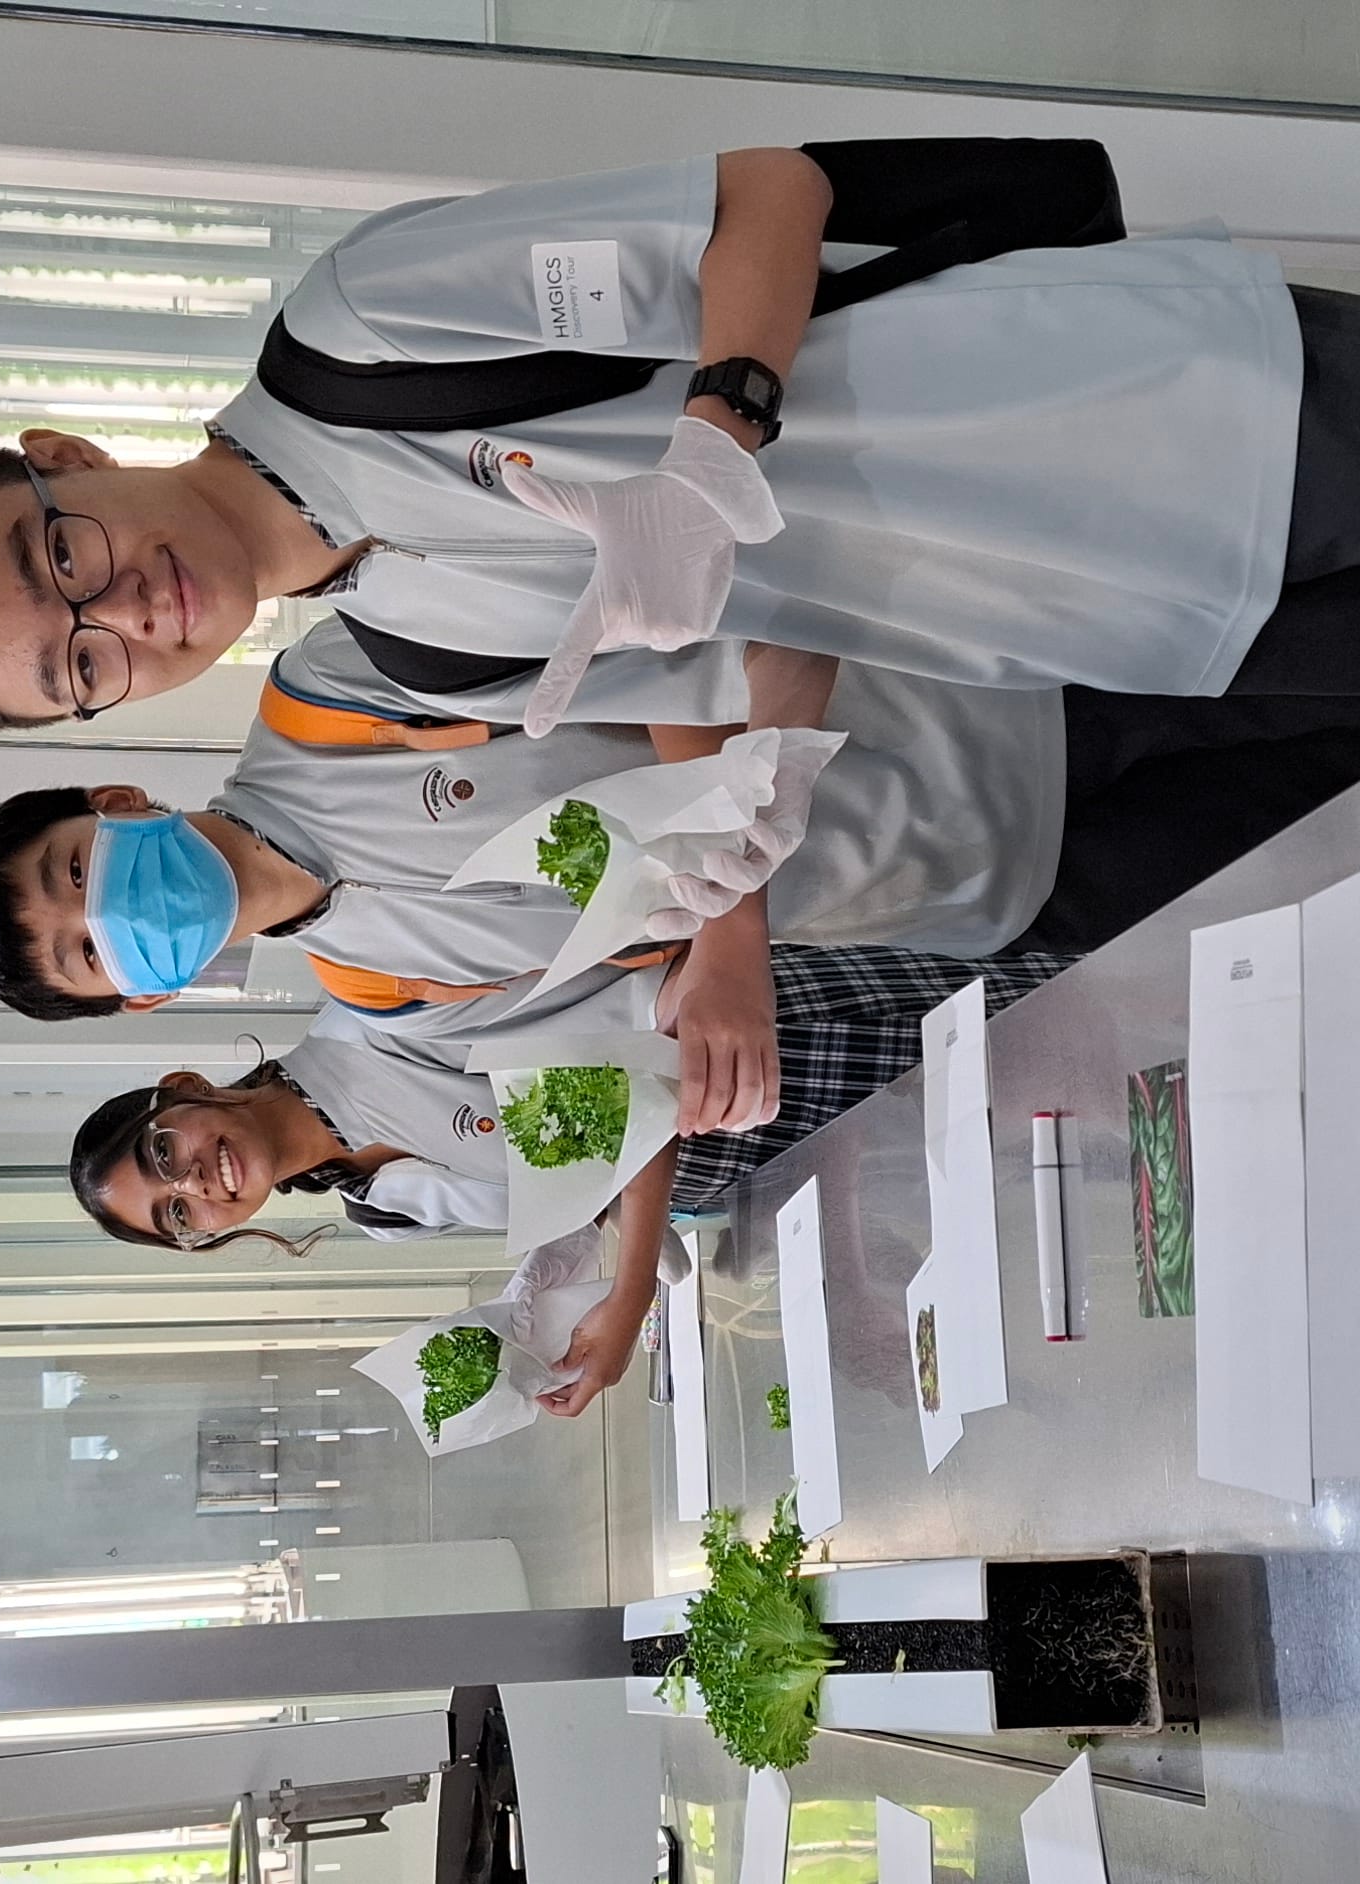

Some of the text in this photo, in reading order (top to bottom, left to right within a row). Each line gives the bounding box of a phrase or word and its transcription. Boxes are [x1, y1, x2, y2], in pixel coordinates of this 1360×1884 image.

[566, 256, 576, 281] Tour
[546, 257, 570, 338] HMGICS
[589, 289, 605, 302] 4
